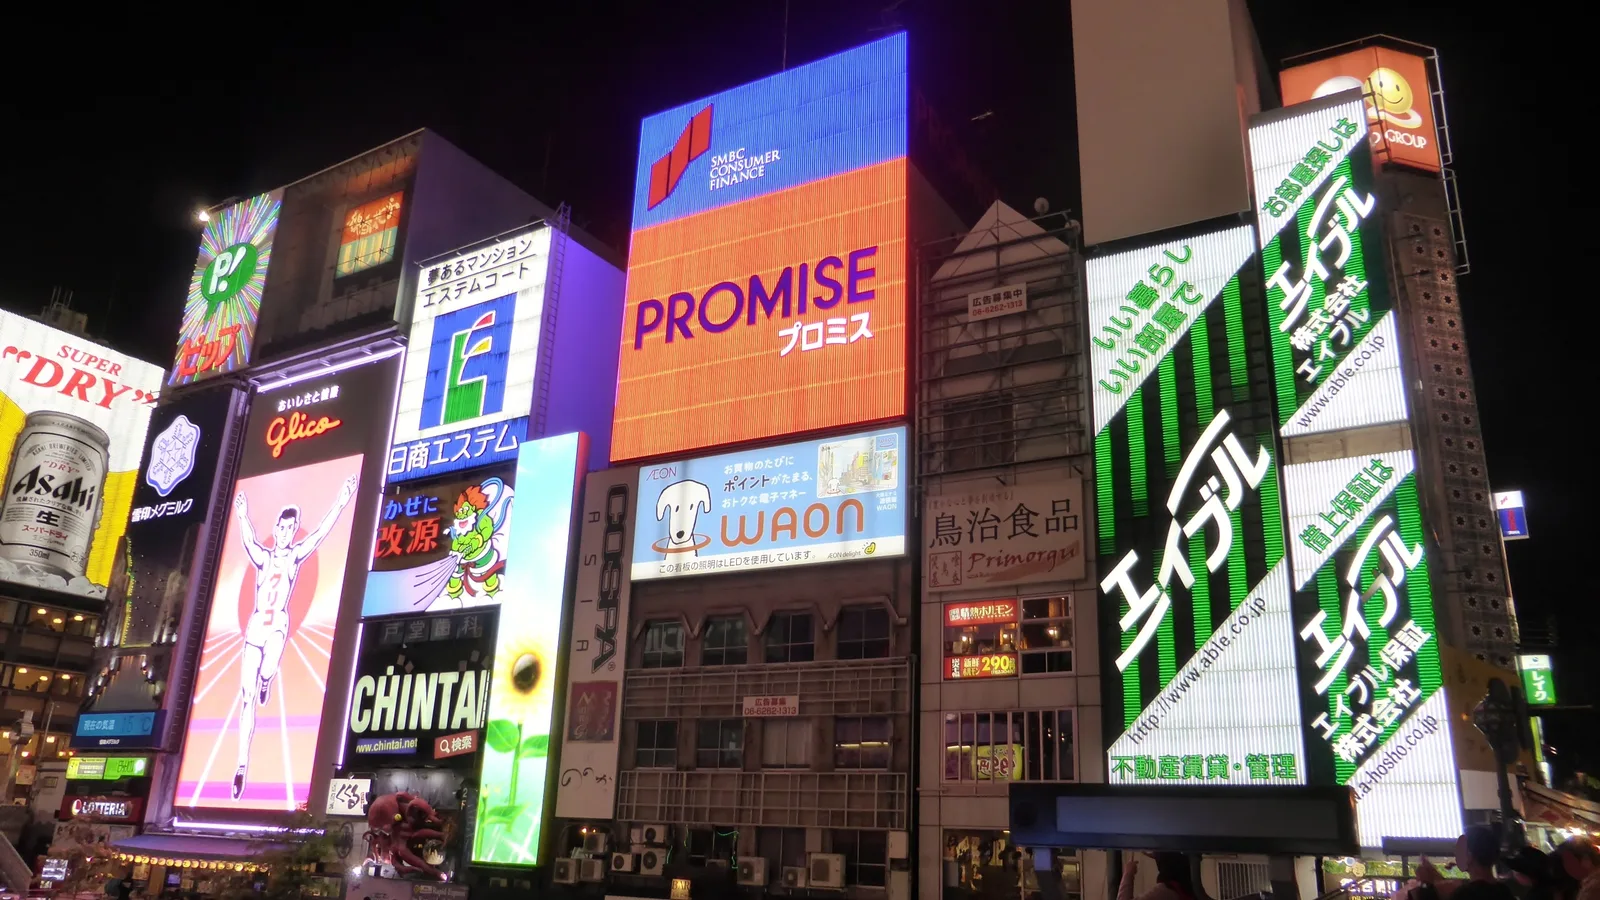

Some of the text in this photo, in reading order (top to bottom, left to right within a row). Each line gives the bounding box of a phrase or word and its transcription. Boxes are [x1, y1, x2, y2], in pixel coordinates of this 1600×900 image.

[711, 147, 745, 168] SMBC
[1385, 129, 1427, 149] GROUP
[709, 165, 765, 191] FINANCE
[710, 150, 781, 179] CONSUMER
[1262, 117, 1358, 218] お部屋探しは
[428, 239, 532, 286] 夢あるマンション
[1265, 175, 1376, 332] エイブル
[423, 262, 529, 309] エステムコート
[634, 246, 878, 350] PROMISE
[1092, 244, 1192, 350] いい暮らし
[778, 311, 874, 357] プロミス
[1289, 274, 1369, 352] 株式会社
[1099, 280, 1204, 394] いい部屋で
[1296, 307, 1370, 384] エイブル
[57, 345, 122, 376] SUPER
[1297, 333, 1386, 429] www.able.co.jp
[266, 411, 341, 458] Glico
[388, 423, 519, 474] 日商エステム
[13, 465, 95, 511] Asahi
[724, 456, 795, 475] お買物のたびに
[36, 511, 60, 527] 生
[384, 495, 438, 520] かぜに
[929, 499, 1078, 549] 鳥治食品
[22, 525, 68, 541] スーパードライ
[375, 517, 441, 558] 改源
[1100, 408, 1271, 674] エイブル
[591, 483, 629, 674] COSPA
[659, 550, 816, 574] この看板の照明はLEDを使用しています。
[1300, 514, 1424, 695] エイブル
[982, 655, 1009, 673] 290
[1127, 595, 1267, 746] http://www.able.co.jp
[1311, 619, 1431, 741] エイブル保証
[1532, 671, 1547, 701] レイク
[744, 706, 797, 715] 06-6262-1313
[1332, 678, 1422, 763] 株式会社
[451, 735, 472, 751] 検索
[1111, 753, 1297, 781] 不動産賃貸・管理
[82, 801, 126, 816] LOTTERIA
